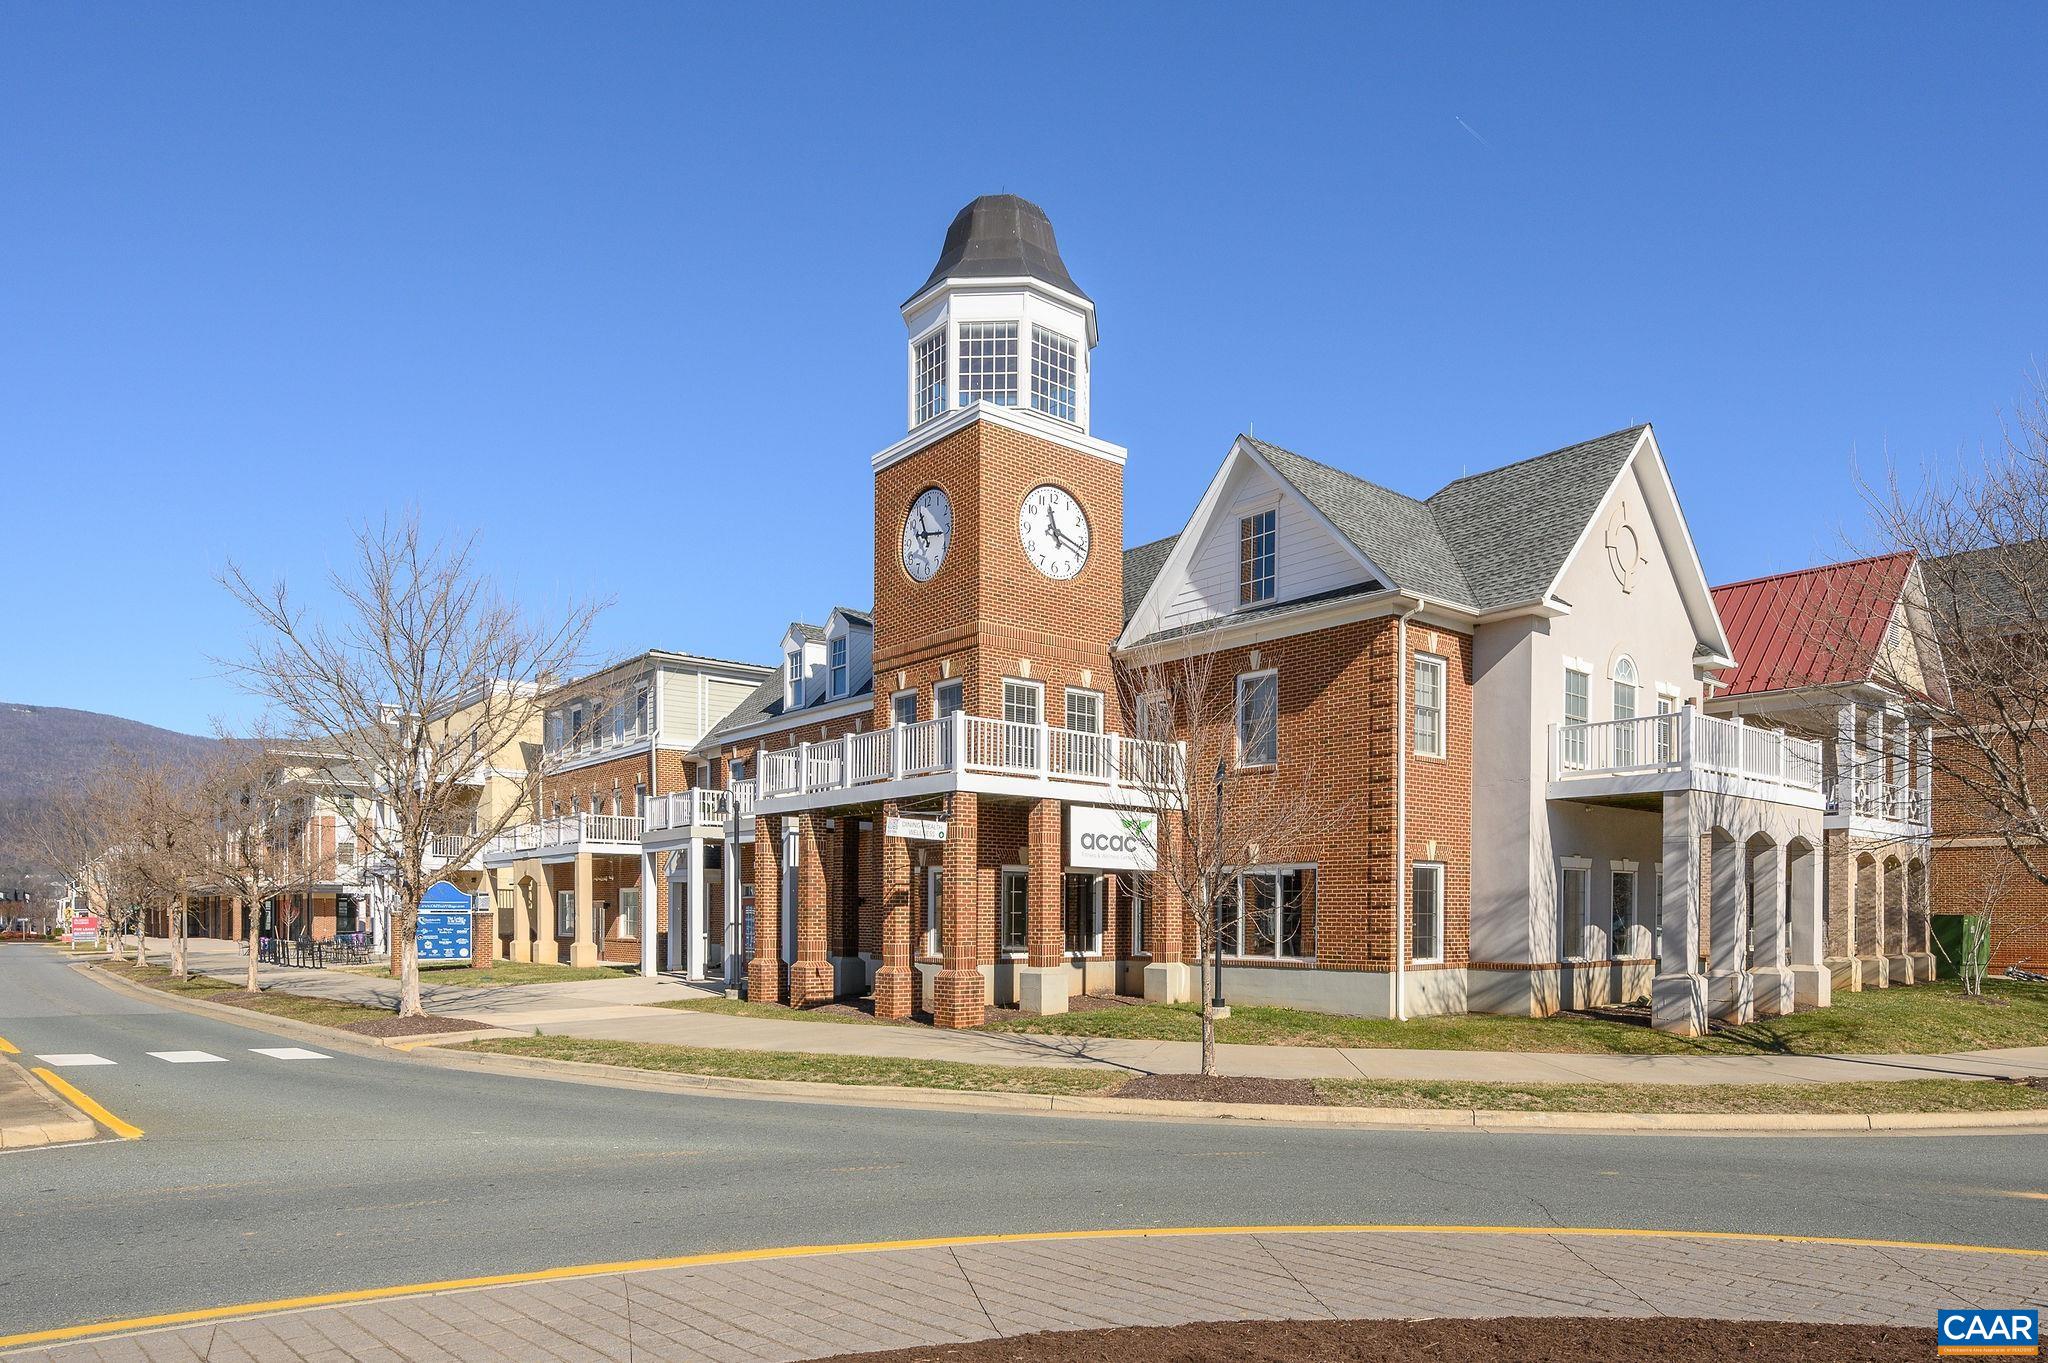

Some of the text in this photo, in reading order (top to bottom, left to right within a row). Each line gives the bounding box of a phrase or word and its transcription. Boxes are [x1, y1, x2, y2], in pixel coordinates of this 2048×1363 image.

[924, 495, 931, 508] 12
[1039, 495, 1044, 505] 11
[1050, 493, 1058, 504] 12
[943, 505, 948, 516] 2
[1028, 504, 1037, 515] 10
[909, 519, 916, 531] 10
[1075, 516, 1080, 527] 2
[945, 523, 950, 534] 3
[1023, 522, 1031, 534] 9
[906, 539, 911, 551] 9
[942, 541, 947, 552] 4
[1028, 540, 1035, 552] 8
[1078, 536, 1084, 547] 3
[908, 554, 913, 565] 8
[934, 555, 939, 567] 5
[1039, 554, 1046, 565] 7
[916, 563, 920, 574] 7
[924, 564, 930, 575] 6
[1051, 561, 1058, 574] 6
[1065, 560, 1070, 572] 5
[1080, 832, 1137, 853] acac
